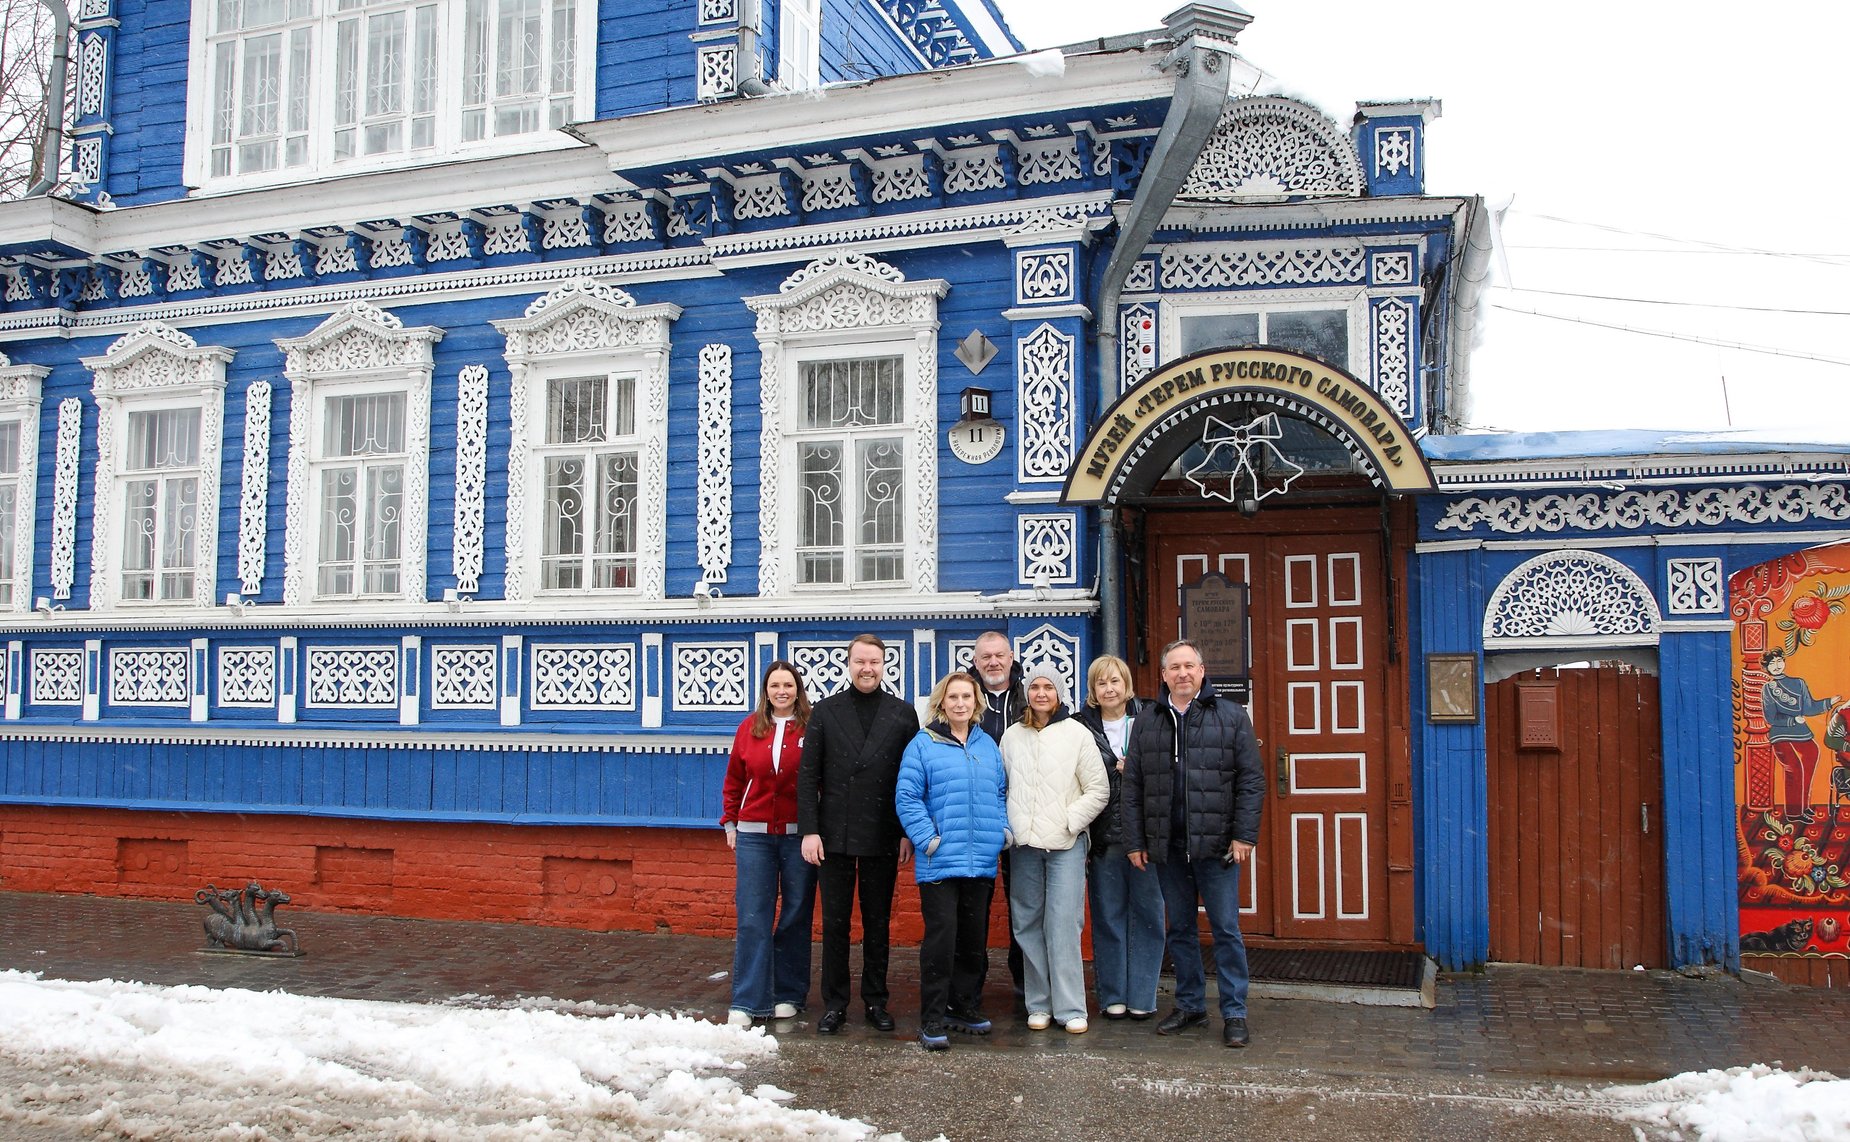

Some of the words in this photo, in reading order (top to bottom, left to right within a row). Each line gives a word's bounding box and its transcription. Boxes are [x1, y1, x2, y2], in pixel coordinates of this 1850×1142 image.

[975, 397, 985, 411] 11
[1086, 412, 1136, 479] МУЗЕЙ
[1134, 367, 1206, 419] «ТЕРЕМ
[1211, 360, 1313, 388] РУССКОГО
[1317, 376, 1403, 467] САМОВАРА»
[969, 428, 984, 443] 11
[952, 440, 982, 460] НАБЕРЕЖНАЯ
